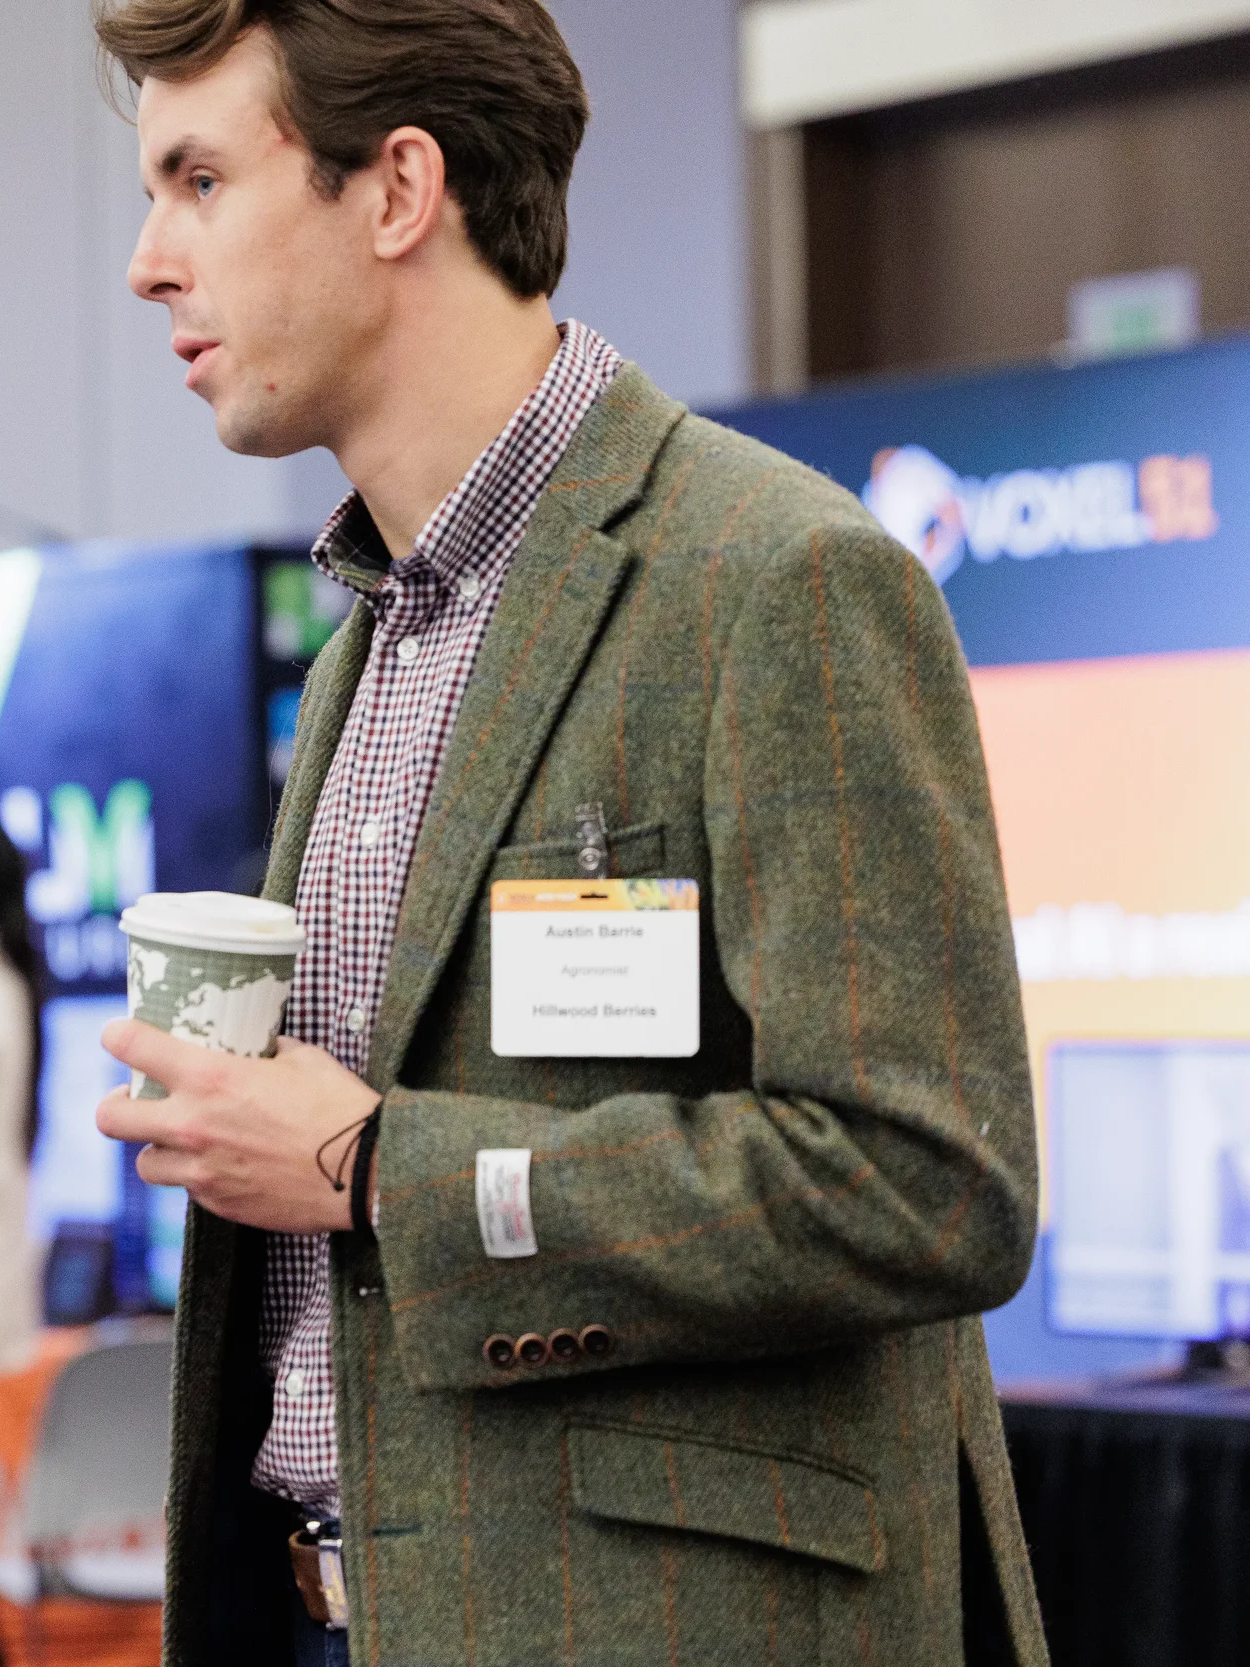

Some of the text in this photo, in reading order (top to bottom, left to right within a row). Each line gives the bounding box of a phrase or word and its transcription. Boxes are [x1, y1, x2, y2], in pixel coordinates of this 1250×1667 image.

[545, 924, 644, 939] Austin Barrie
[561, 964, 629, 978] Agronomist
[532, 1003, 657, 1018] Hillwood Berries
